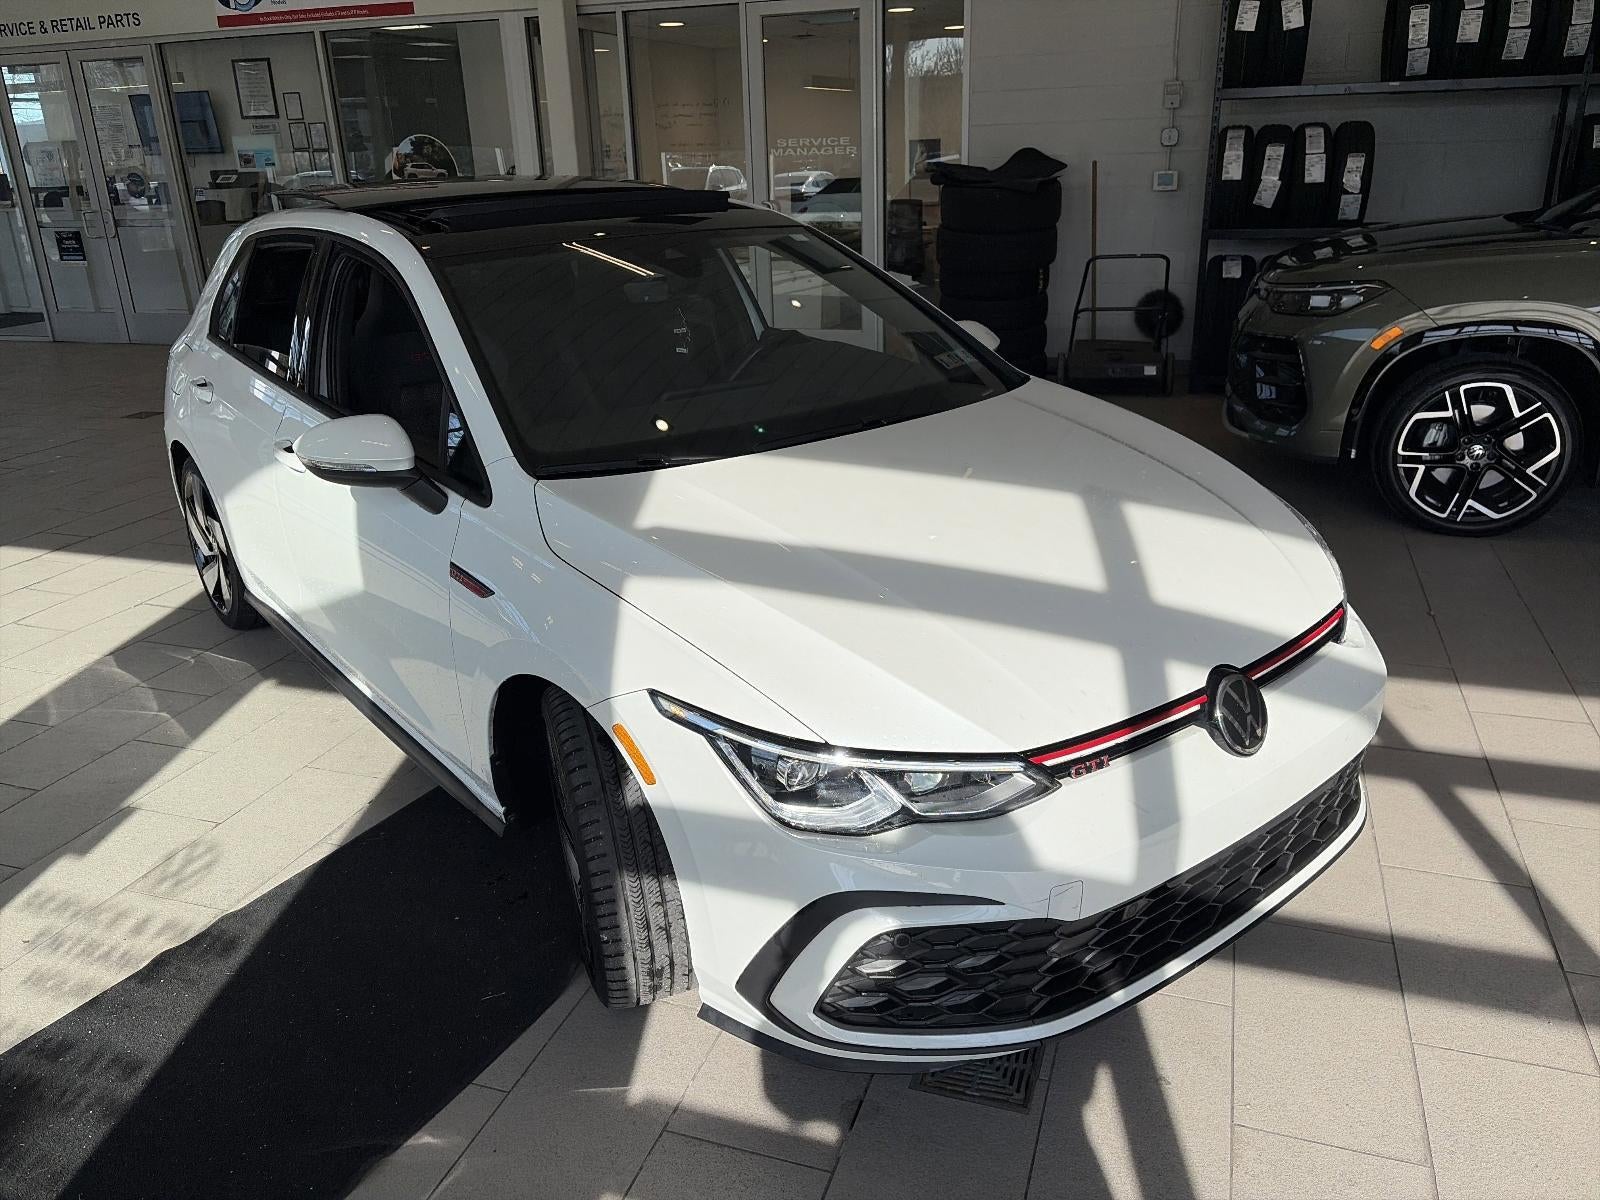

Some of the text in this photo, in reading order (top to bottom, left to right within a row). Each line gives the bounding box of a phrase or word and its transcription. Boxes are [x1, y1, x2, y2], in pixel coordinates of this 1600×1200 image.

[39, 20, 49, 34] &
[51, 16, 96, 34] RETAIL
[98, 12, 141, 29] PARTS
[776, 137, 851, 147] SERVICE
[770, 146, 858, 156] MANAGER
[1070, 754, 1111, 779] GTI
